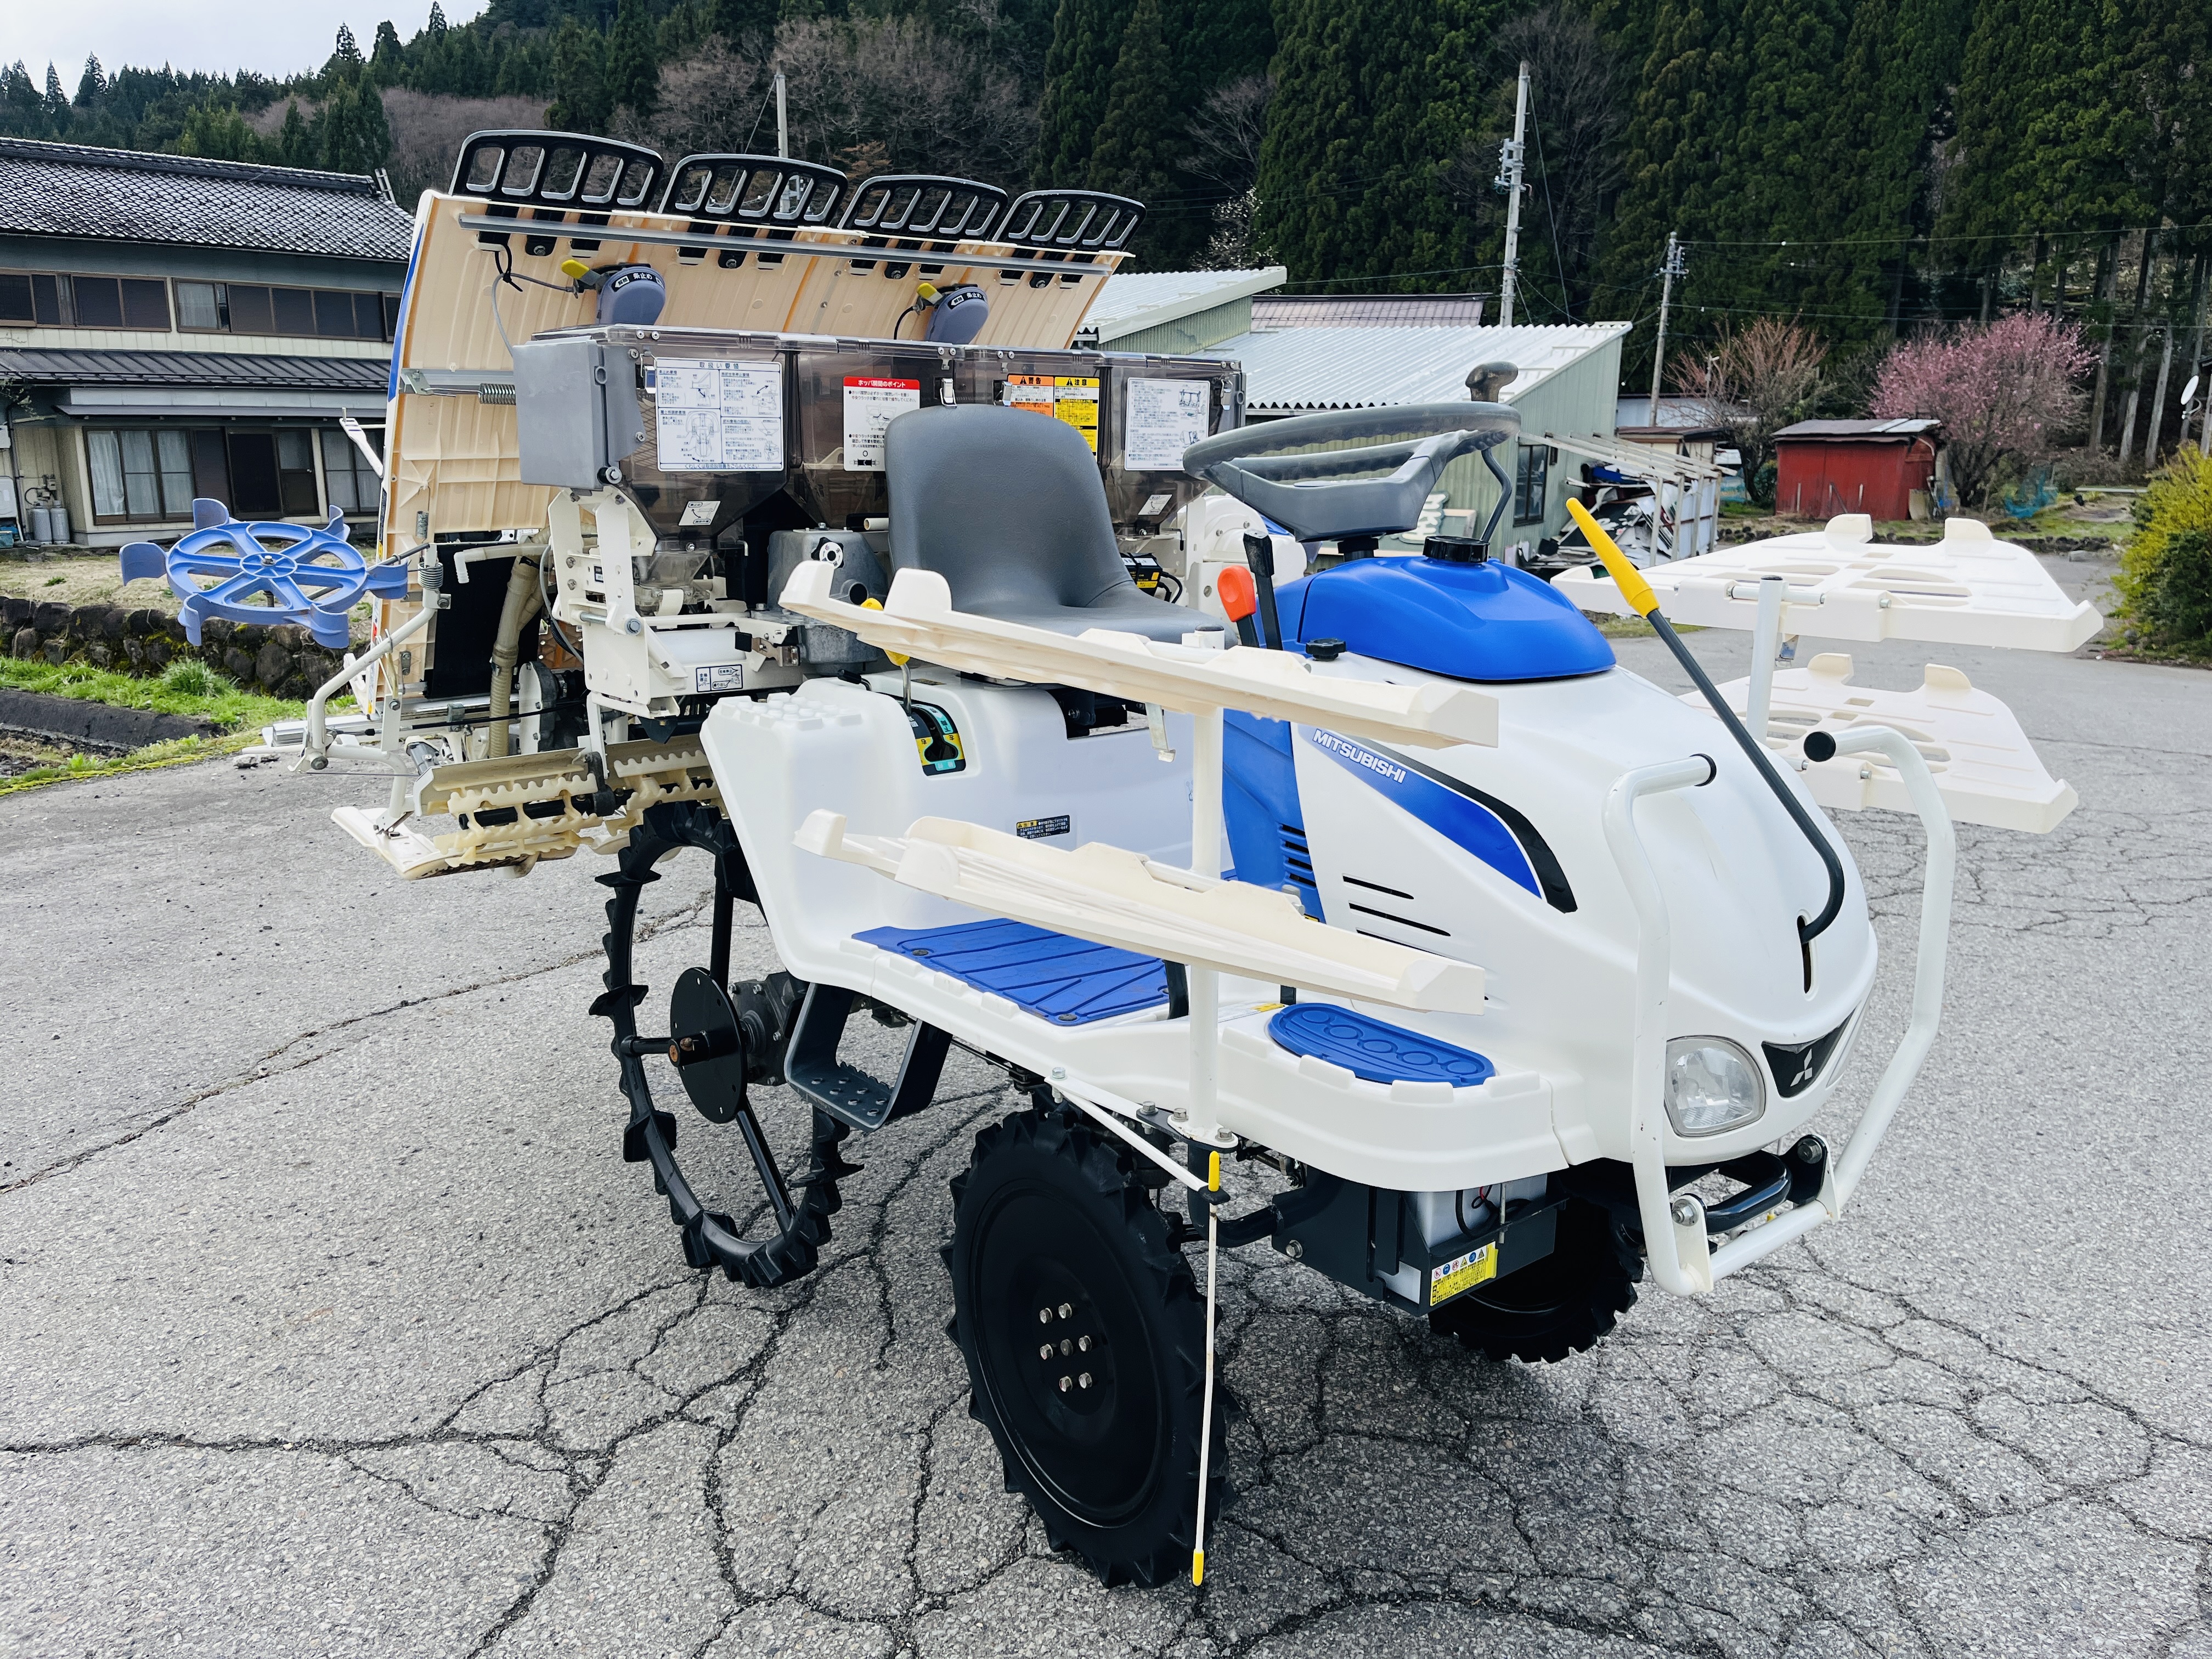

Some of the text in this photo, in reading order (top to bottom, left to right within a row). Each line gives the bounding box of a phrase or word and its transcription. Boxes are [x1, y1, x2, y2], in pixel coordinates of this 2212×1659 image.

[858, 379, 906, 388] ホッパ開閉のポイント
[1312, 729, 1408, 785] MITSUBISHI
